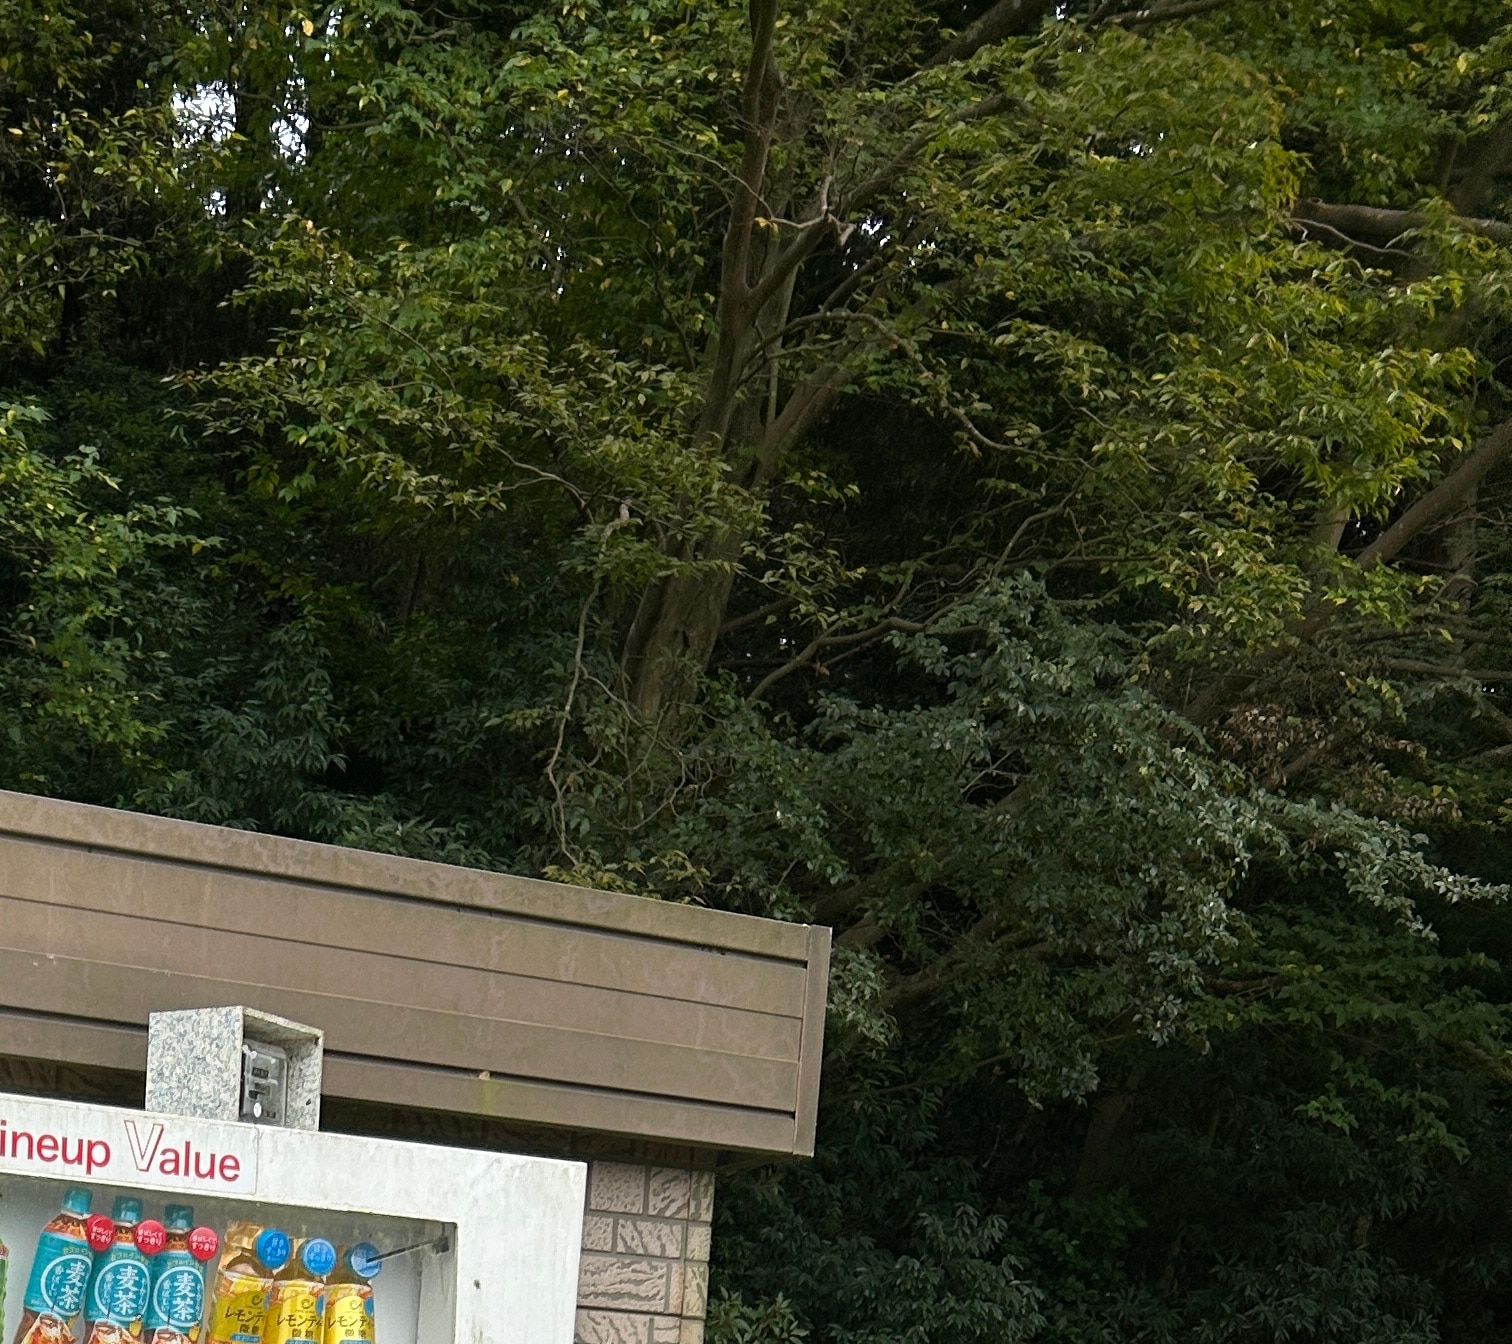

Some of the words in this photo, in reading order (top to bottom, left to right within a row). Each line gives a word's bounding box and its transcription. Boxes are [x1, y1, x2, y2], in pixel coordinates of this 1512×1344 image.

[124, 1119, 241, 1182] Value
[91, 1233, 111, 1244] すっきり
[137, 1236, 162, 1246] すっきり
[192, 1242, 216, 1252] すっきり
[57, 1260, 86, 1310] 麦茶
[113, 1265, 139, 1316] 麦茶
[172, 1271, 196, 1321] 麦茶
